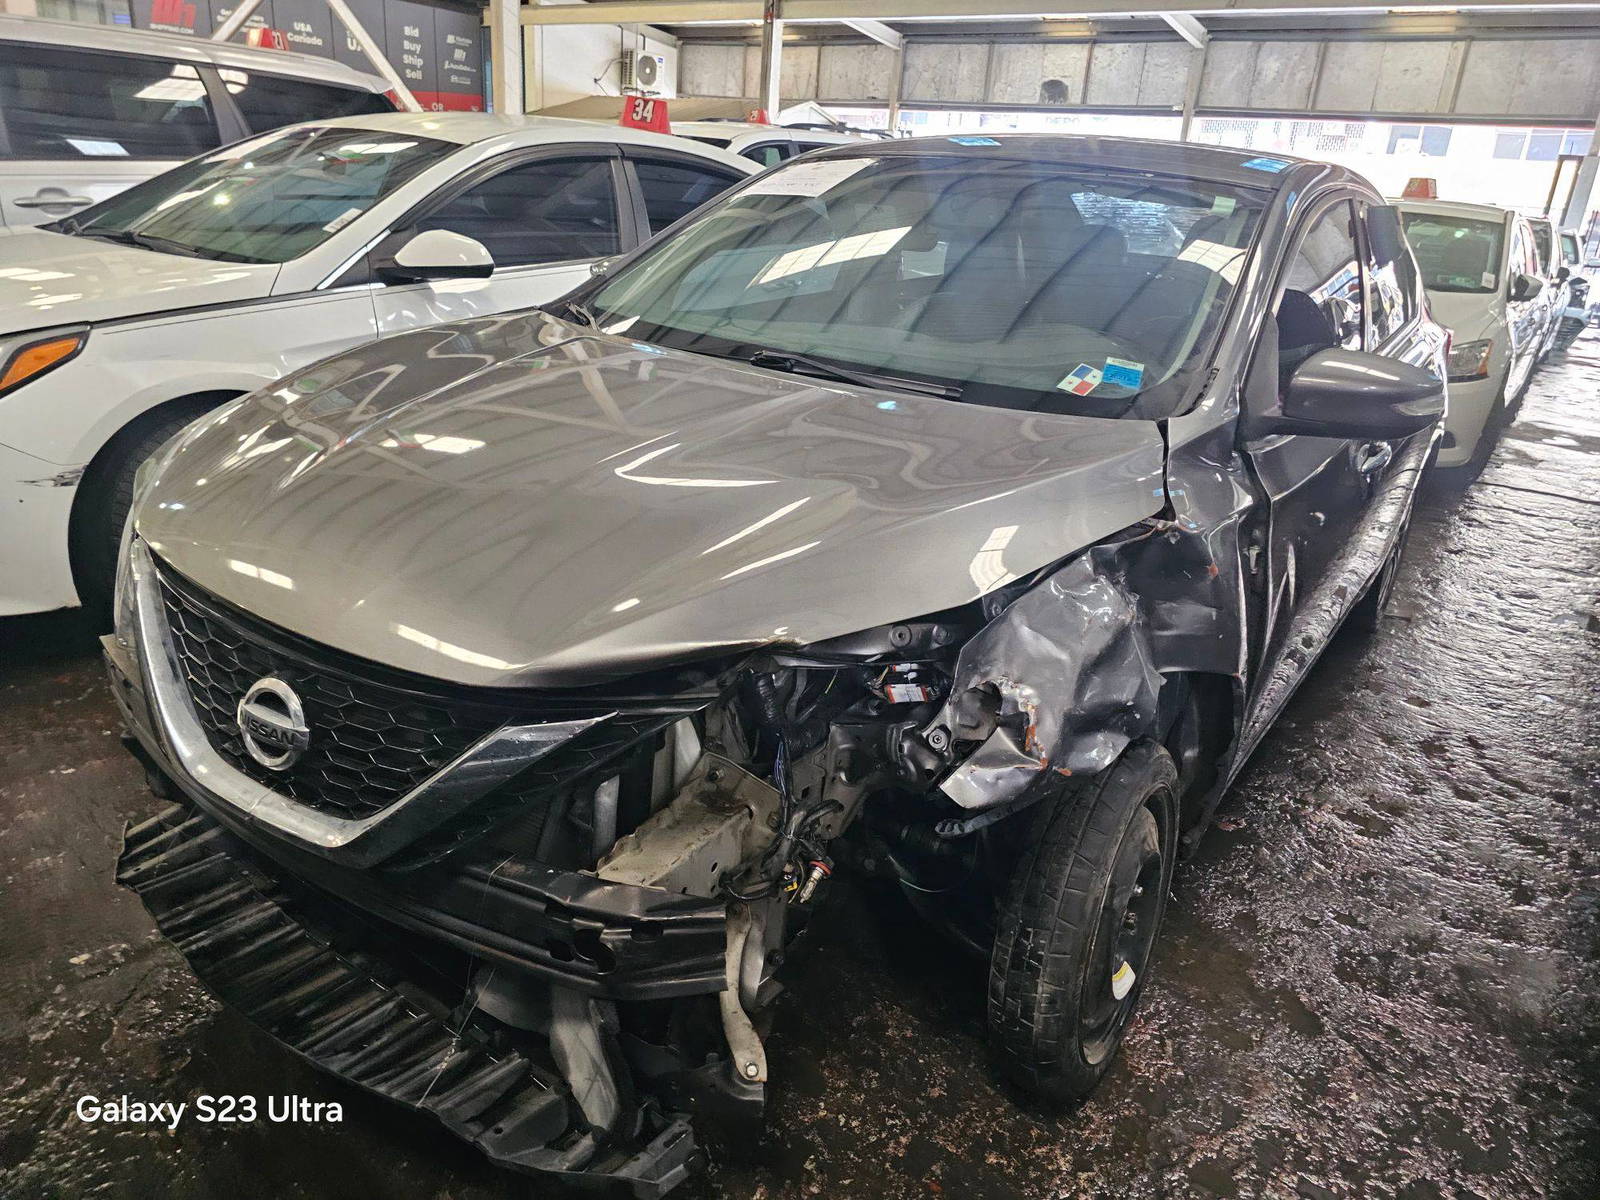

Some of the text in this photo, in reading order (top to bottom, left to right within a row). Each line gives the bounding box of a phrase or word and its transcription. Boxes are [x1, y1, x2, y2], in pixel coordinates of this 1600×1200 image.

[293, 21, 312, 33] USA
[403, 25, 419, 38] Bid
[287, 32, 323, 46] Canada
[403, 40, 421, 54] Buy
[402, 54, 423, 68] Ship
[405, 68, 422, 80] Sell
[632, 99, 654, 122] 34
